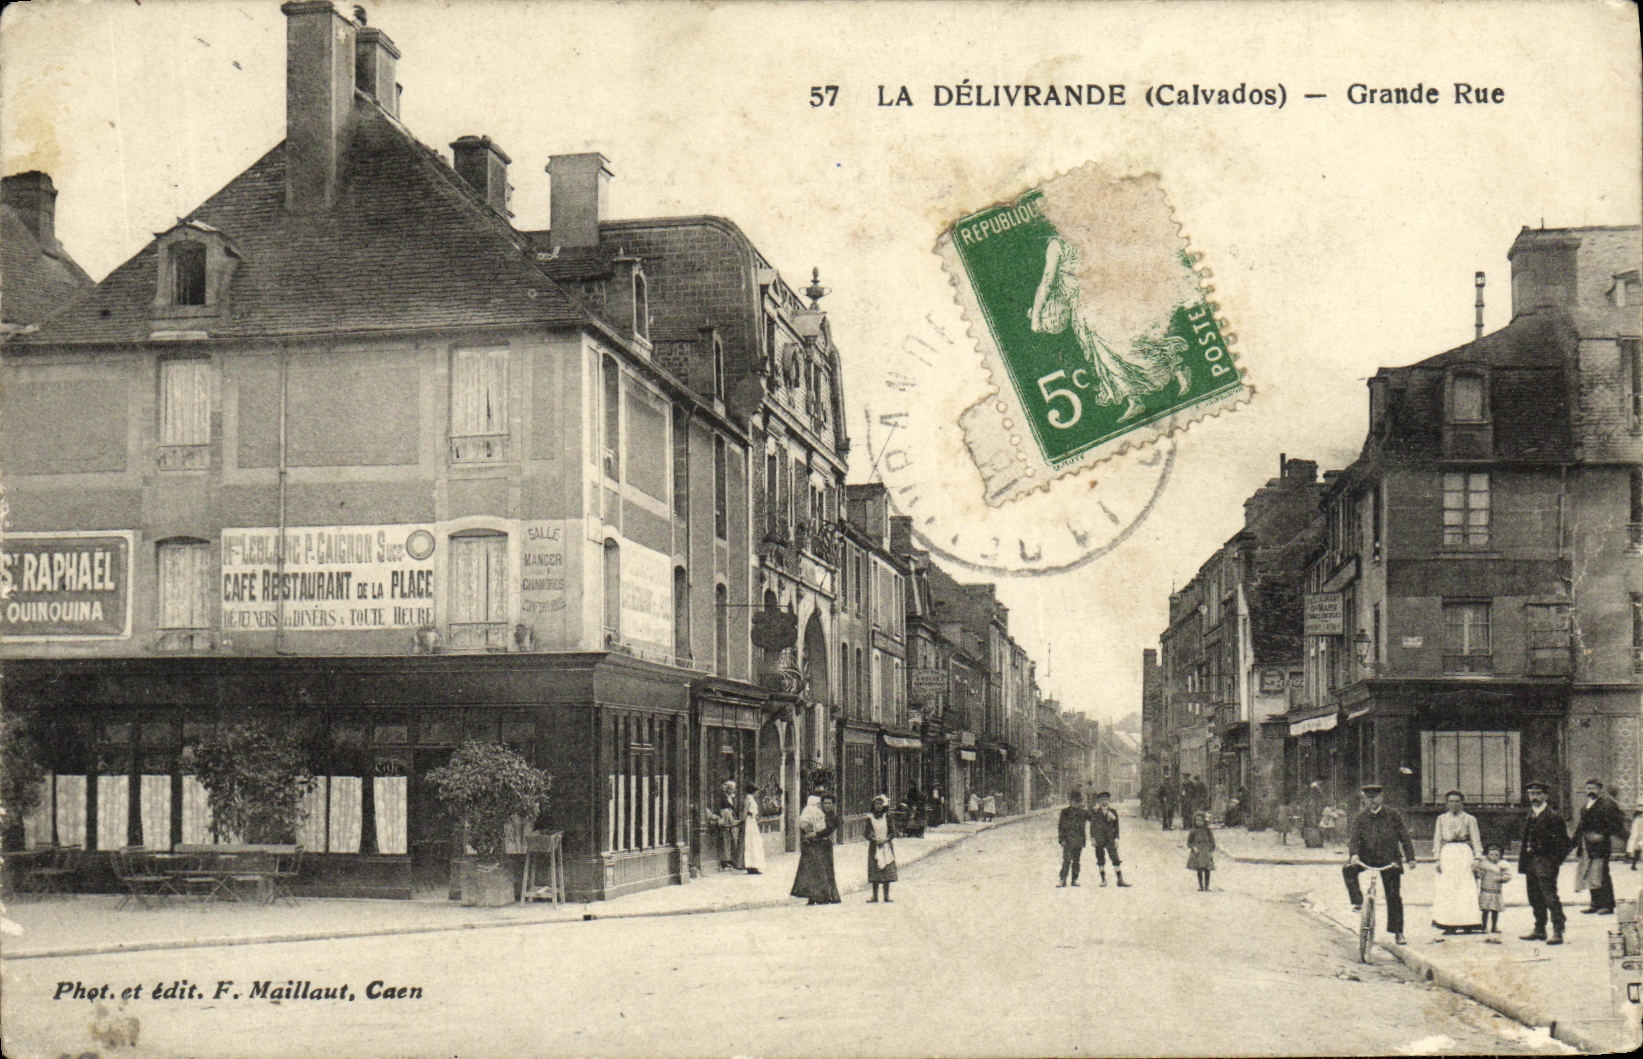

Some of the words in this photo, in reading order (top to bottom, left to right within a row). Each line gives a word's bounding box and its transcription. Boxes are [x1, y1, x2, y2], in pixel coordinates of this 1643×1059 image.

[528, 527, 560, 541] SALLE
[224, 570, 257, 602] CAFÉ
[262, 570, 352, 601] RESTAURANT
[357, 582, 368, 600] DE
[372, 582, 383, 600] LA
[391, 570, 433, 599] PLACE
[350, 608, 385, 626] TOUTE
[394, 606, 434, 625] HEURE
